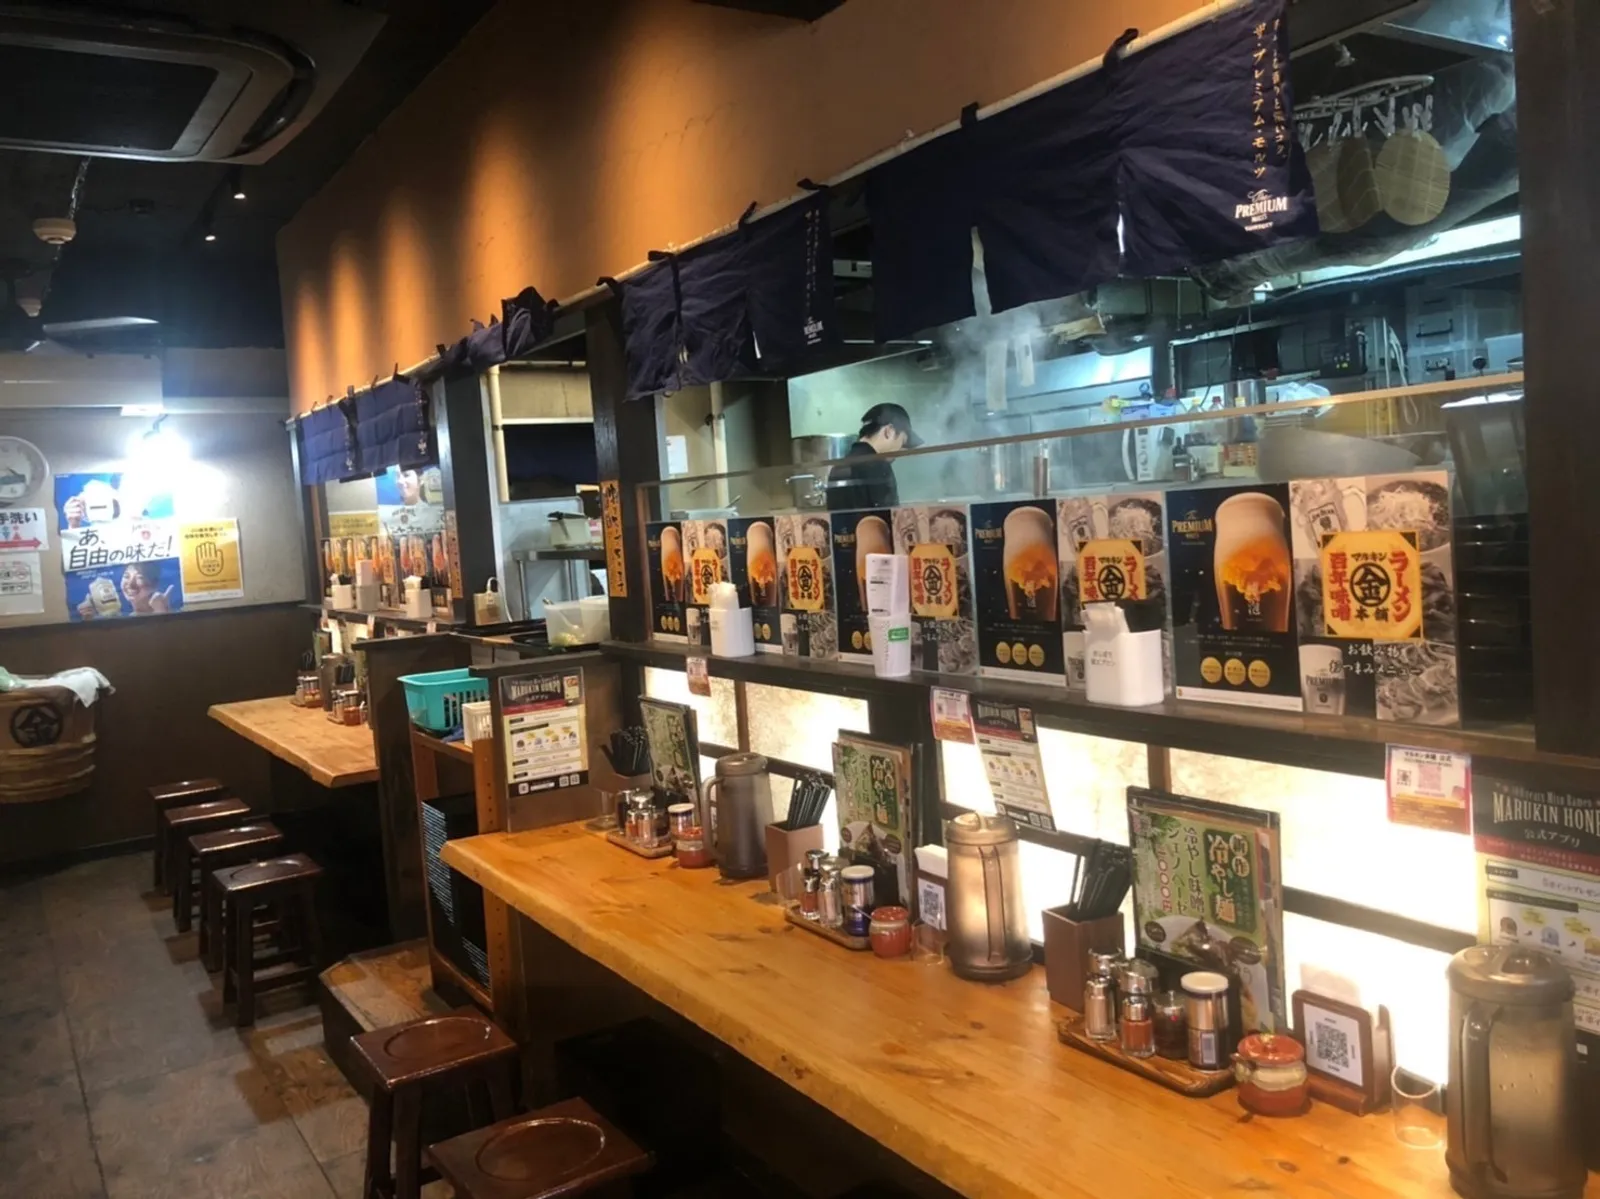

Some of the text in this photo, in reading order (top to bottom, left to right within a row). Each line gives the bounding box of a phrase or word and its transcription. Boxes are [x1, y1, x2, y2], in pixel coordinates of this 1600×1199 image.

[1234, 196, 1288, 219] PREMIUM
[1171, 518, 1213, 533] PREMIUM
[1351, 551, 1387, 562] マルキン
[1101, 568, 1123, 599] 金
[1329, 552, 1351, 622] 百年味噌
[1354, 565, 1389, 604] 金
[1389, 550, 1411, 622] ラーメン
[1493, 791, 1558, 825] MARUKIN
[1524, 828, 1580, 848] 公式アプリ
